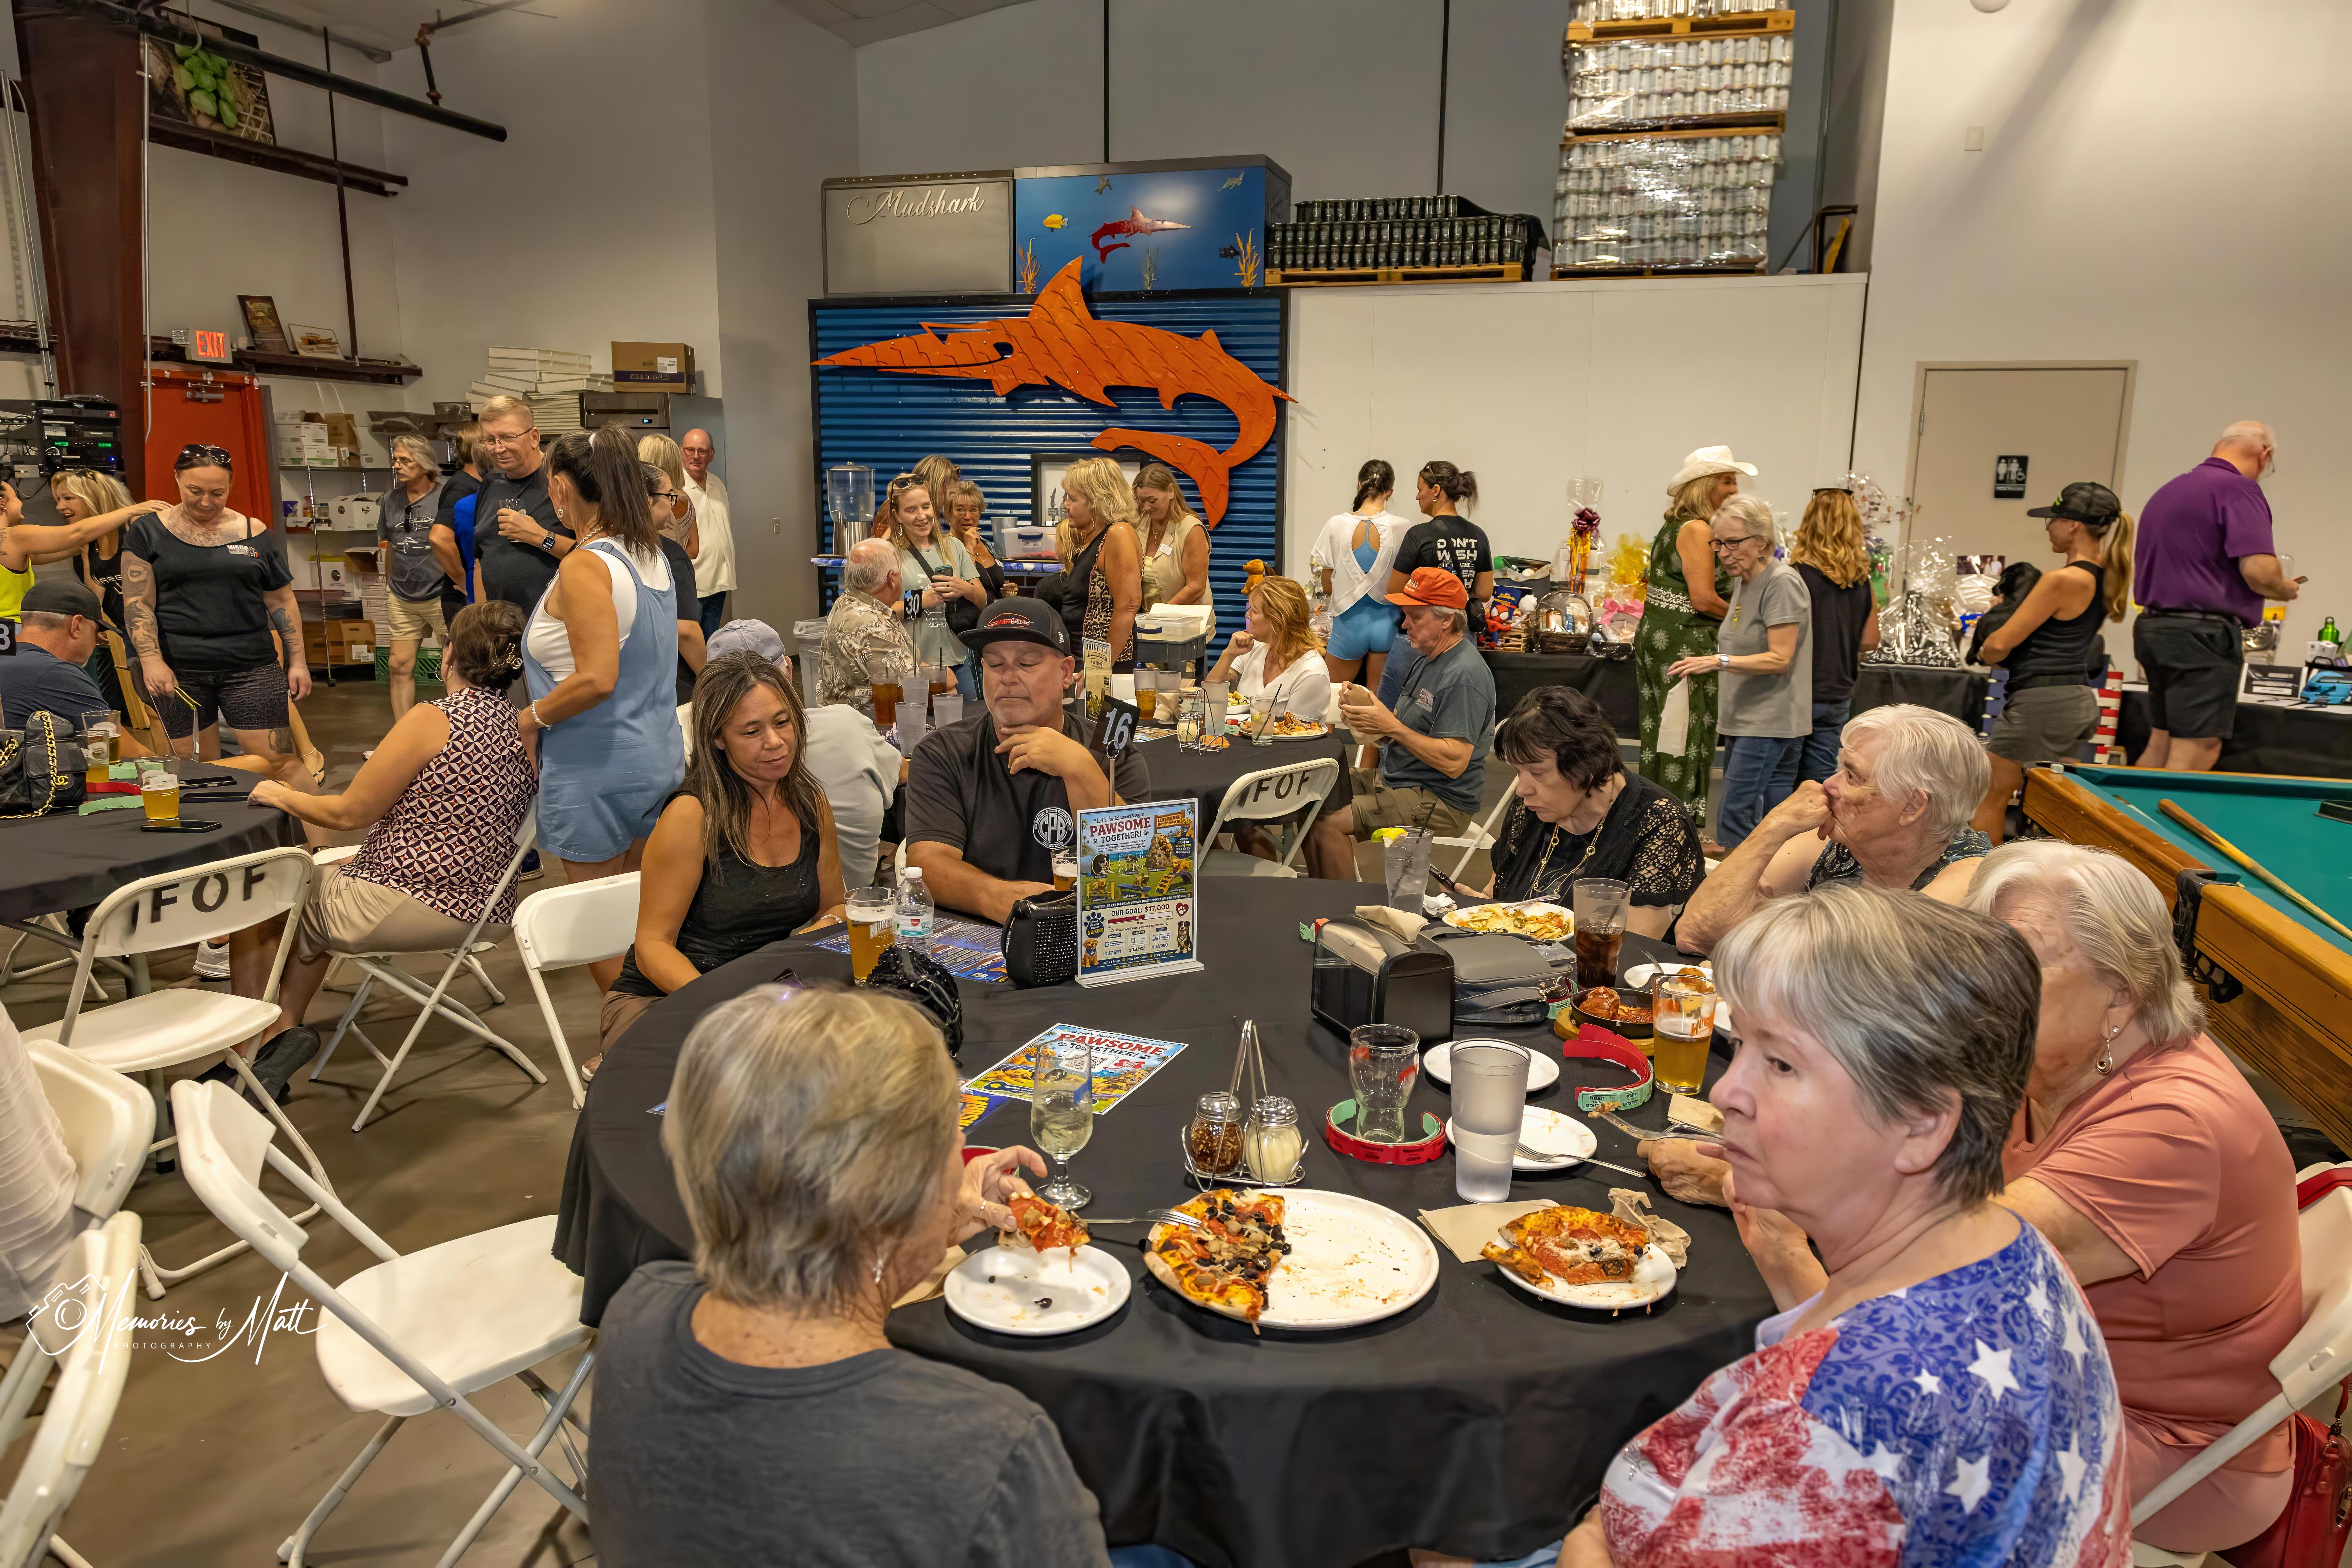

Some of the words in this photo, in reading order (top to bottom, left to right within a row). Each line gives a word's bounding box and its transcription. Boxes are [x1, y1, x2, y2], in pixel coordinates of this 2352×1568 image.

[848, 186, 985, 225] Mudshark
[196, 330, 225, 358] EXIT
[1437, 550, 1477, 561] WSH
[906, 593, 920, 615] 30
[1103, 708, 1132, 750] 16
[1039, 814, 1066, 842] CPB
[1090, 817, 1151, 837] PAWSOME
[1101, 830, 1142, 843] TOGETHER!
[1144, 904, 1169, 912] $17,000
[1056, 1033, 1167, 1056] PAWSOME
